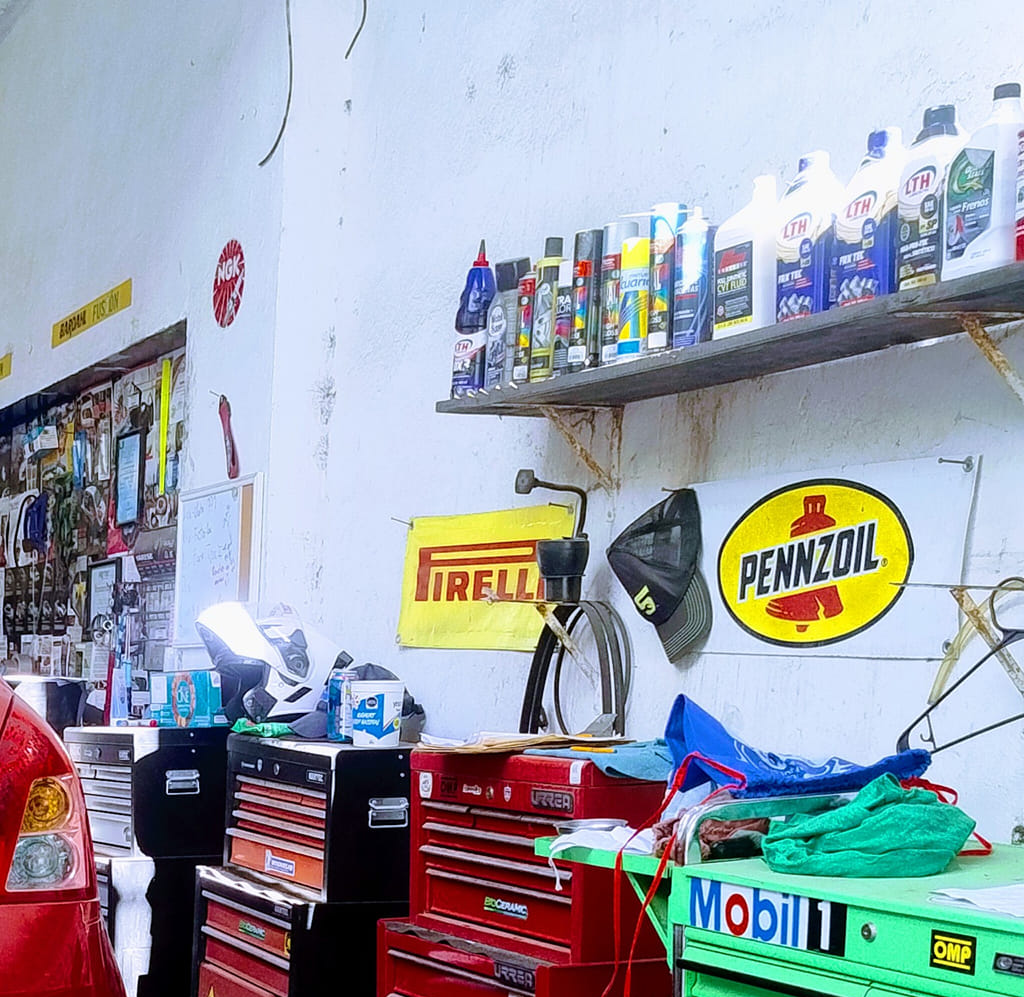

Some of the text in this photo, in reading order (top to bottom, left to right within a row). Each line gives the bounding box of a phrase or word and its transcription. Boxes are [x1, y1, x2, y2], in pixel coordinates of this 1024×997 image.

[905, 172, 931, 195] LTH
[846, 197, 872, 219] LTH
[783, 218, 808, 239] LTH
[217, 253, 241, 287] NGK
[739, 521, 880, 601] PENNZOIL
[690, 877, 832, 951] Mobil 1
[933, 940, 972, 963] OMP
